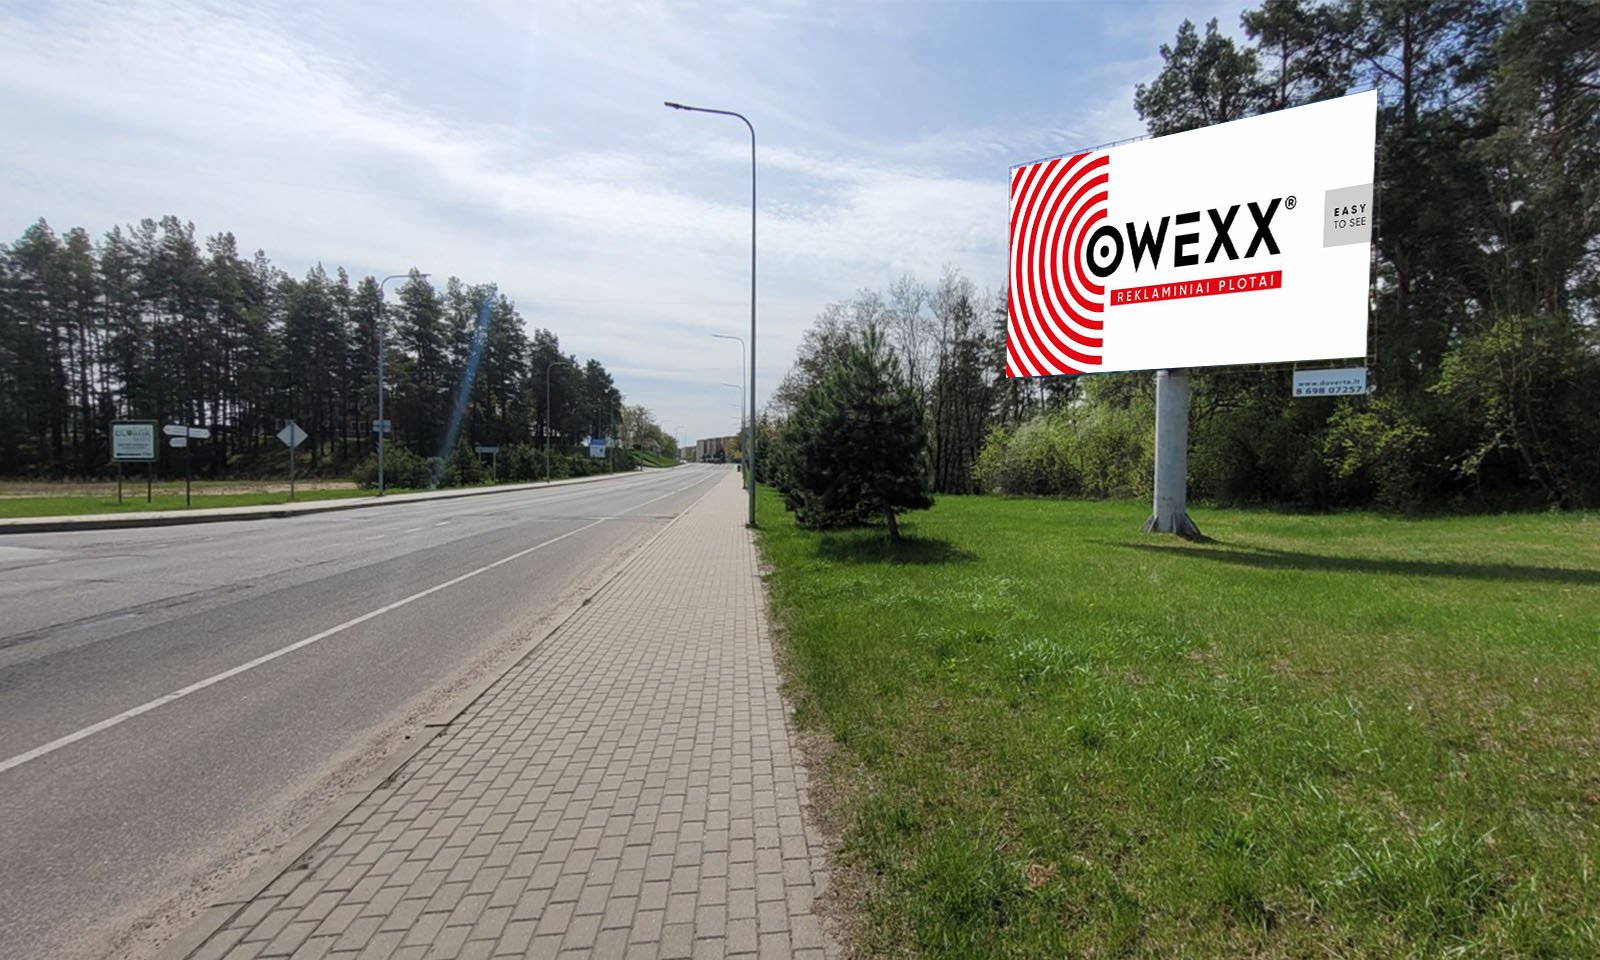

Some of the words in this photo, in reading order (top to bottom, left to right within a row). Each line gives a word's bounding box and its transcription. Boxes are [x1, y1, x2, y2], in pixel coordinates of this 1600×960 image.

[1334, 203, 1367, 217] EASY
[1333, 219, 1347, 230] TO
[1349, 216, 1367, 227] SEE
[1117, 284, 1211, 303] REKLAMINIAI
[1218, 273, 1275, 291] PLOTAI
[1328, 385, 1362, 394] 07257
